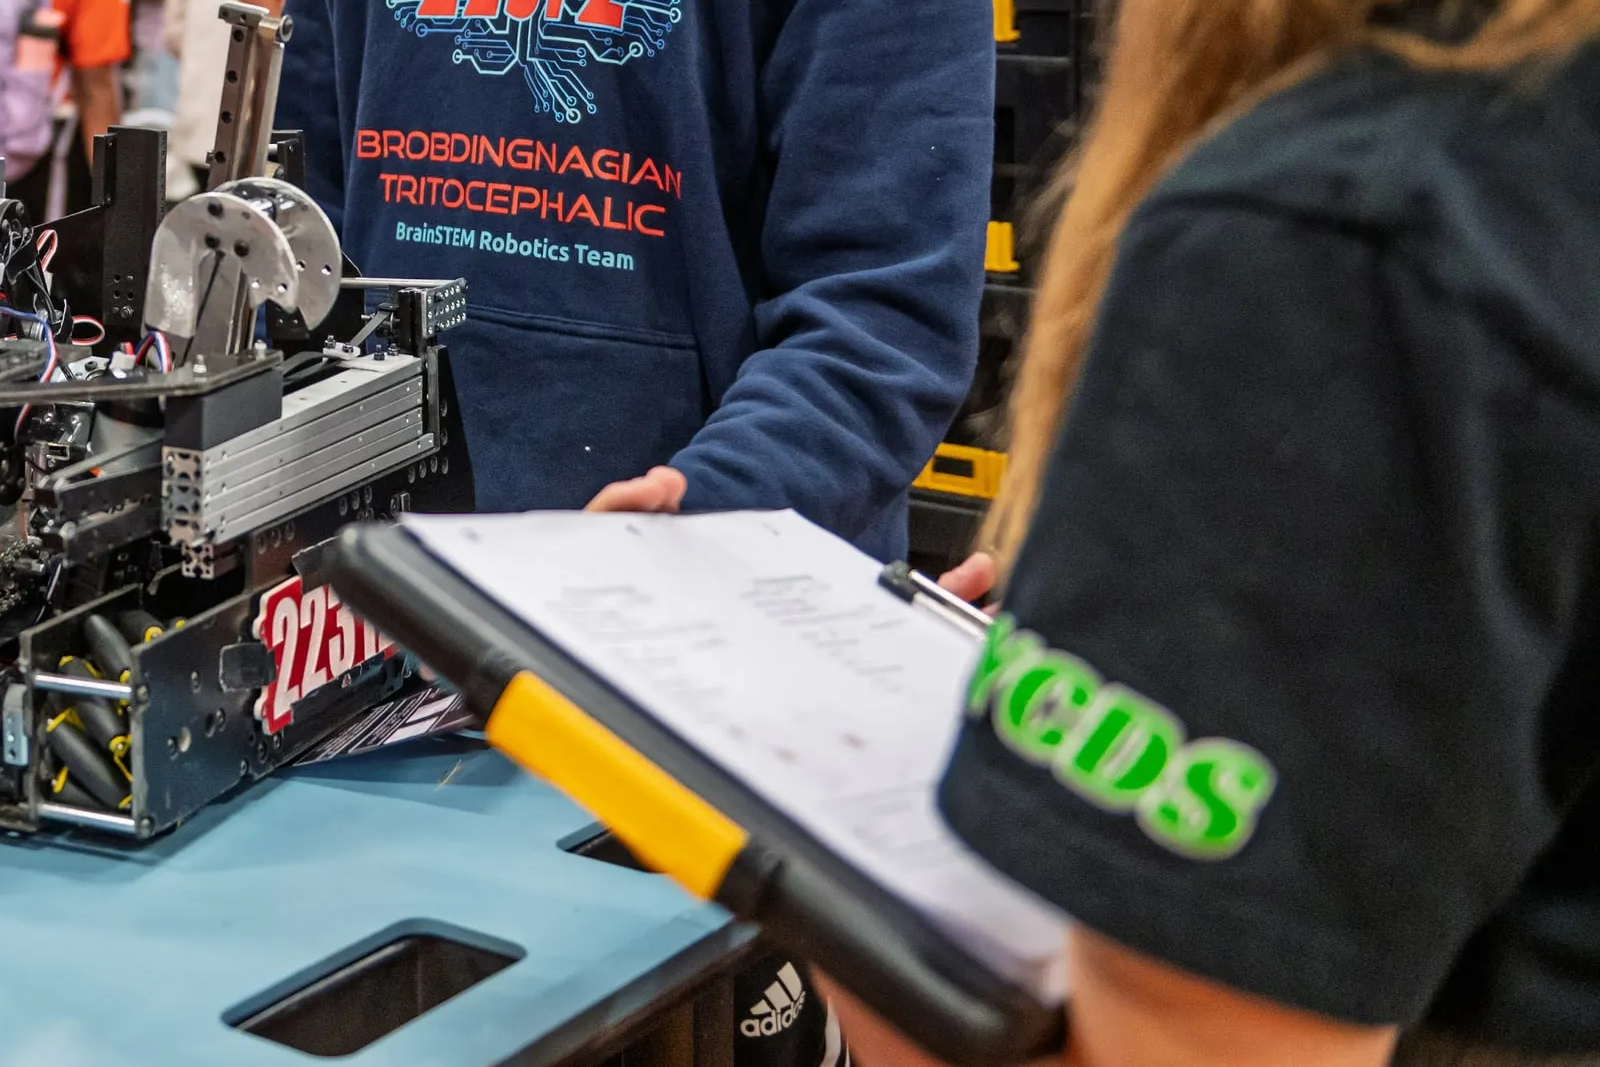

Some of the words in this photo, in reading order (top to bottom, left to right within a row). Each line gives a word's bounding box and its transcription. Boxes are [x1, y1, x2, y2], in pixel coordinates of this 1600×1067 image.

[356, 129, 683, 200] BROBDINGNAGIAN
[379, 173, 667, 237] TRITOCEPHALIC
[395, 221, 475, 249] BrainSTEM
[479, 231, 570, 263] Robotics
[574, 244, 635, 271] Team
[271, 584, 397, 721] 223
